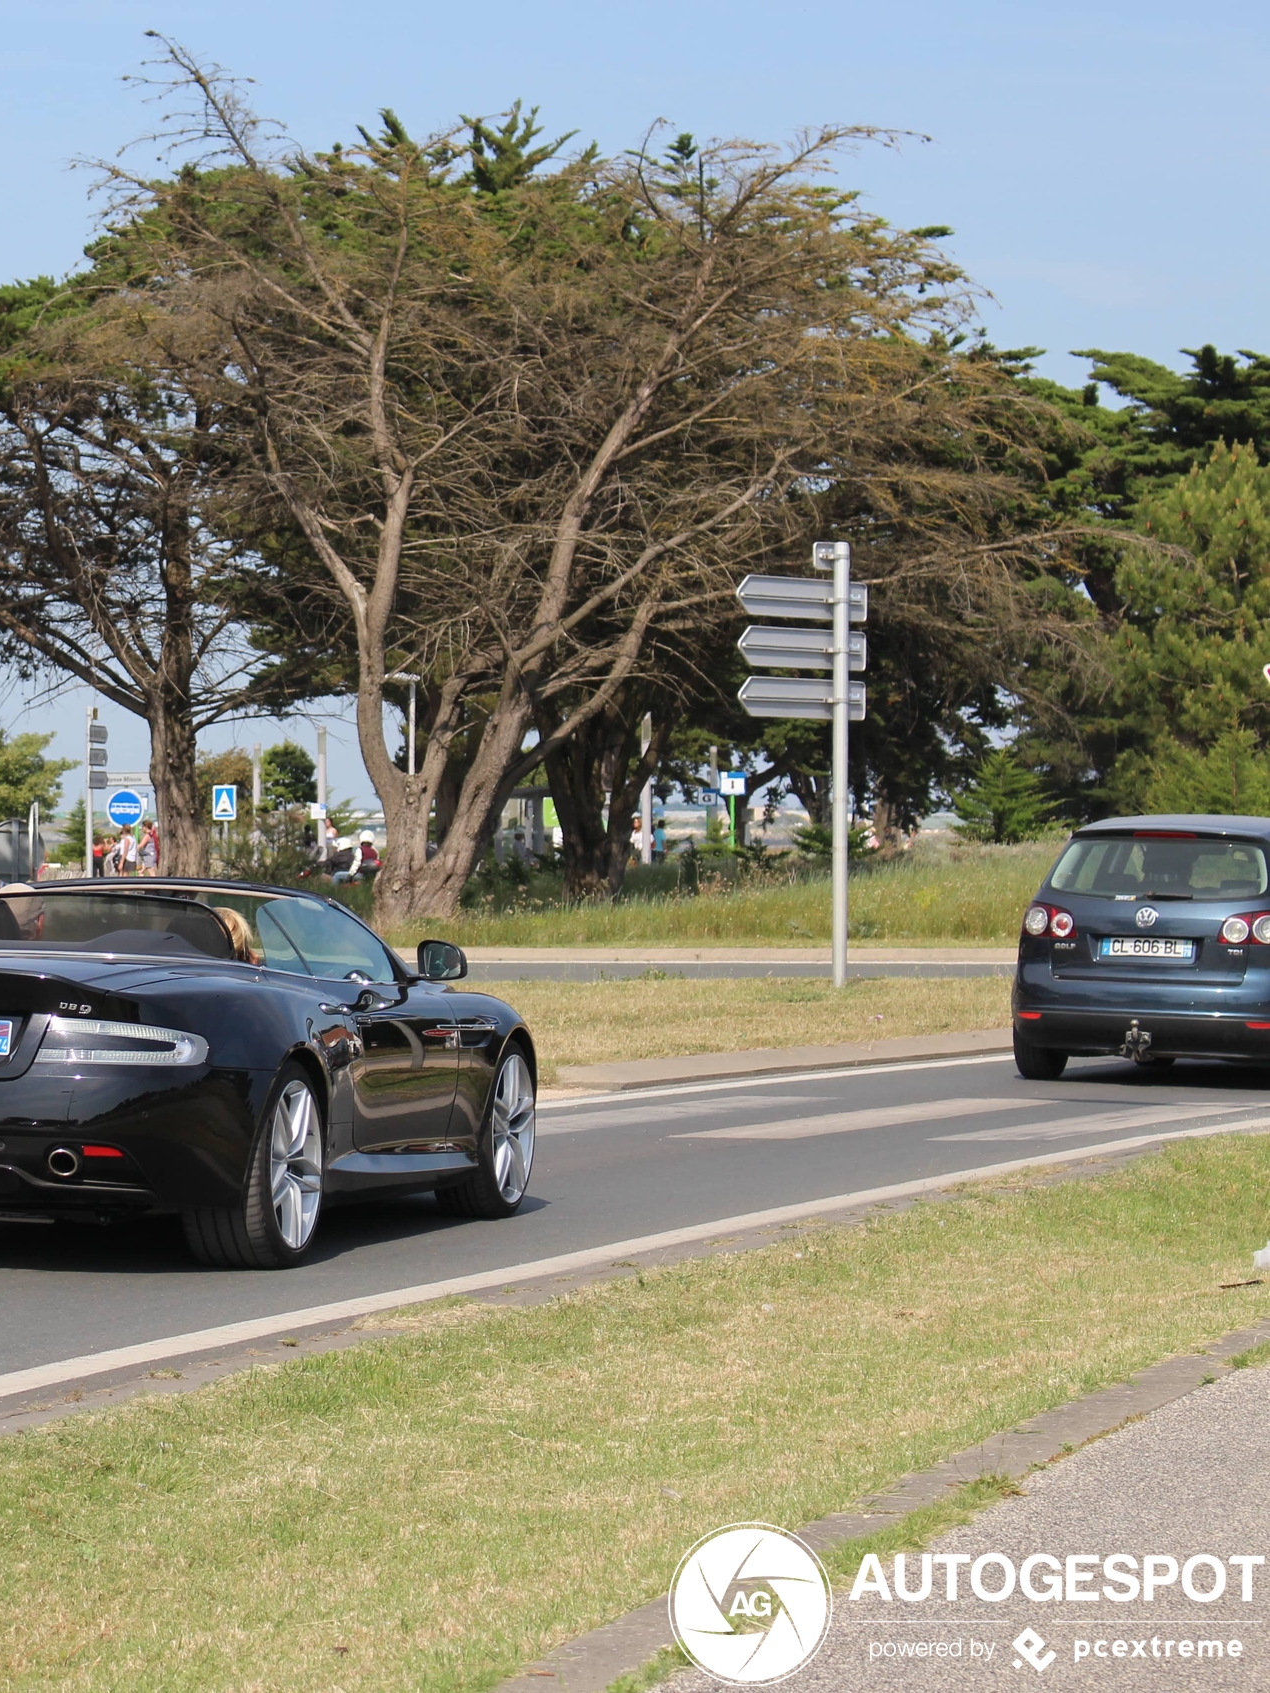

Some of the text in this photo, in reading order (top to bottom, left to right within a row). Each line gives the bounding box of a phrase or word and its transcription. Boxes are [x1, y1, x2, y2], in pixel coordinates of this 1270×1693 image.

[702, 794, 711, 802] G
[1054, 942, 1076, 950] GOLF
[1112, 939, 1182, 955] CL-606-BL
[1227, 948, 1244, 956] TDI
[59, 1001, 92, 1014] DB9
